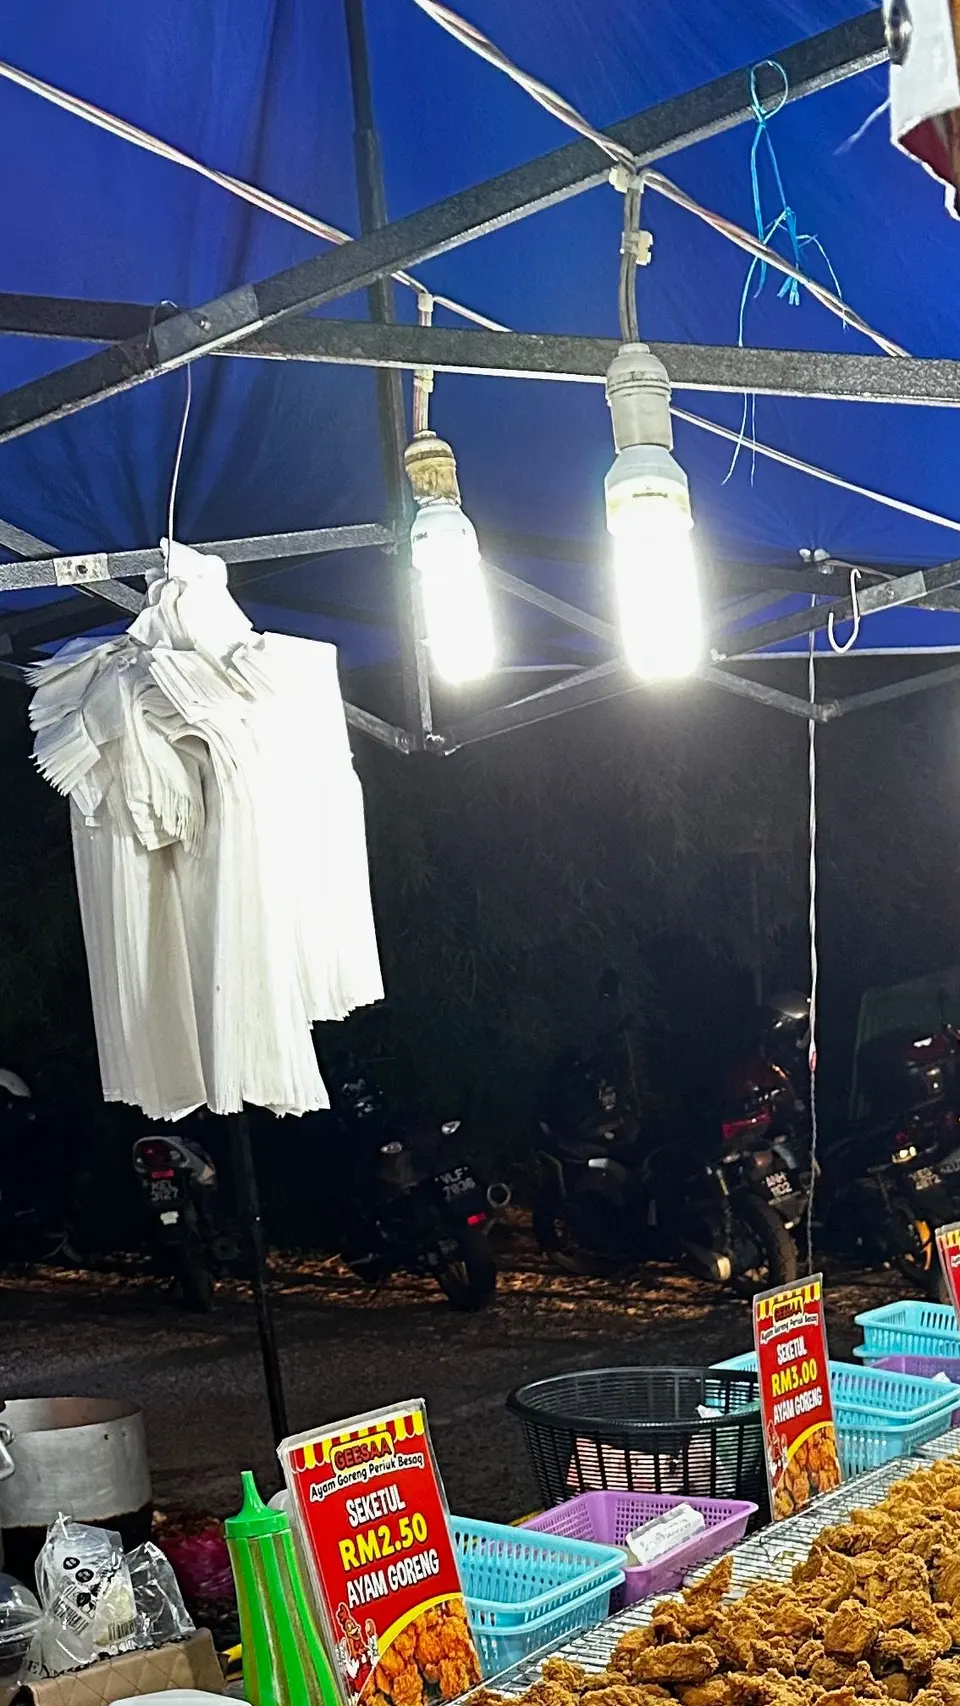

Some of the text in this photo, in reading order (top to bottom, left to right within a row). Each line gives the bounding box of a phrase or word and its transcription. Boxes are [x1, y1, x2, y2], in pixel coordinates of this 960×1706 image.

[776, 1336, 808, 1366] SEKETUL
[771, 1358, 818, 1398] RM3.00
[773, 1386, 823, 1426] AYAM GORENG
[334, 1436, 392, 1471] GEESAA
[310, 1453, 423, 1500] Ayam Goreng Periuk Besaq
[346, 1484, 406, 1528] SEKETUL
[338, 1512, 428, 1571] RM2.50
[346, 1549, 440, 1609] AYAM GORENG
